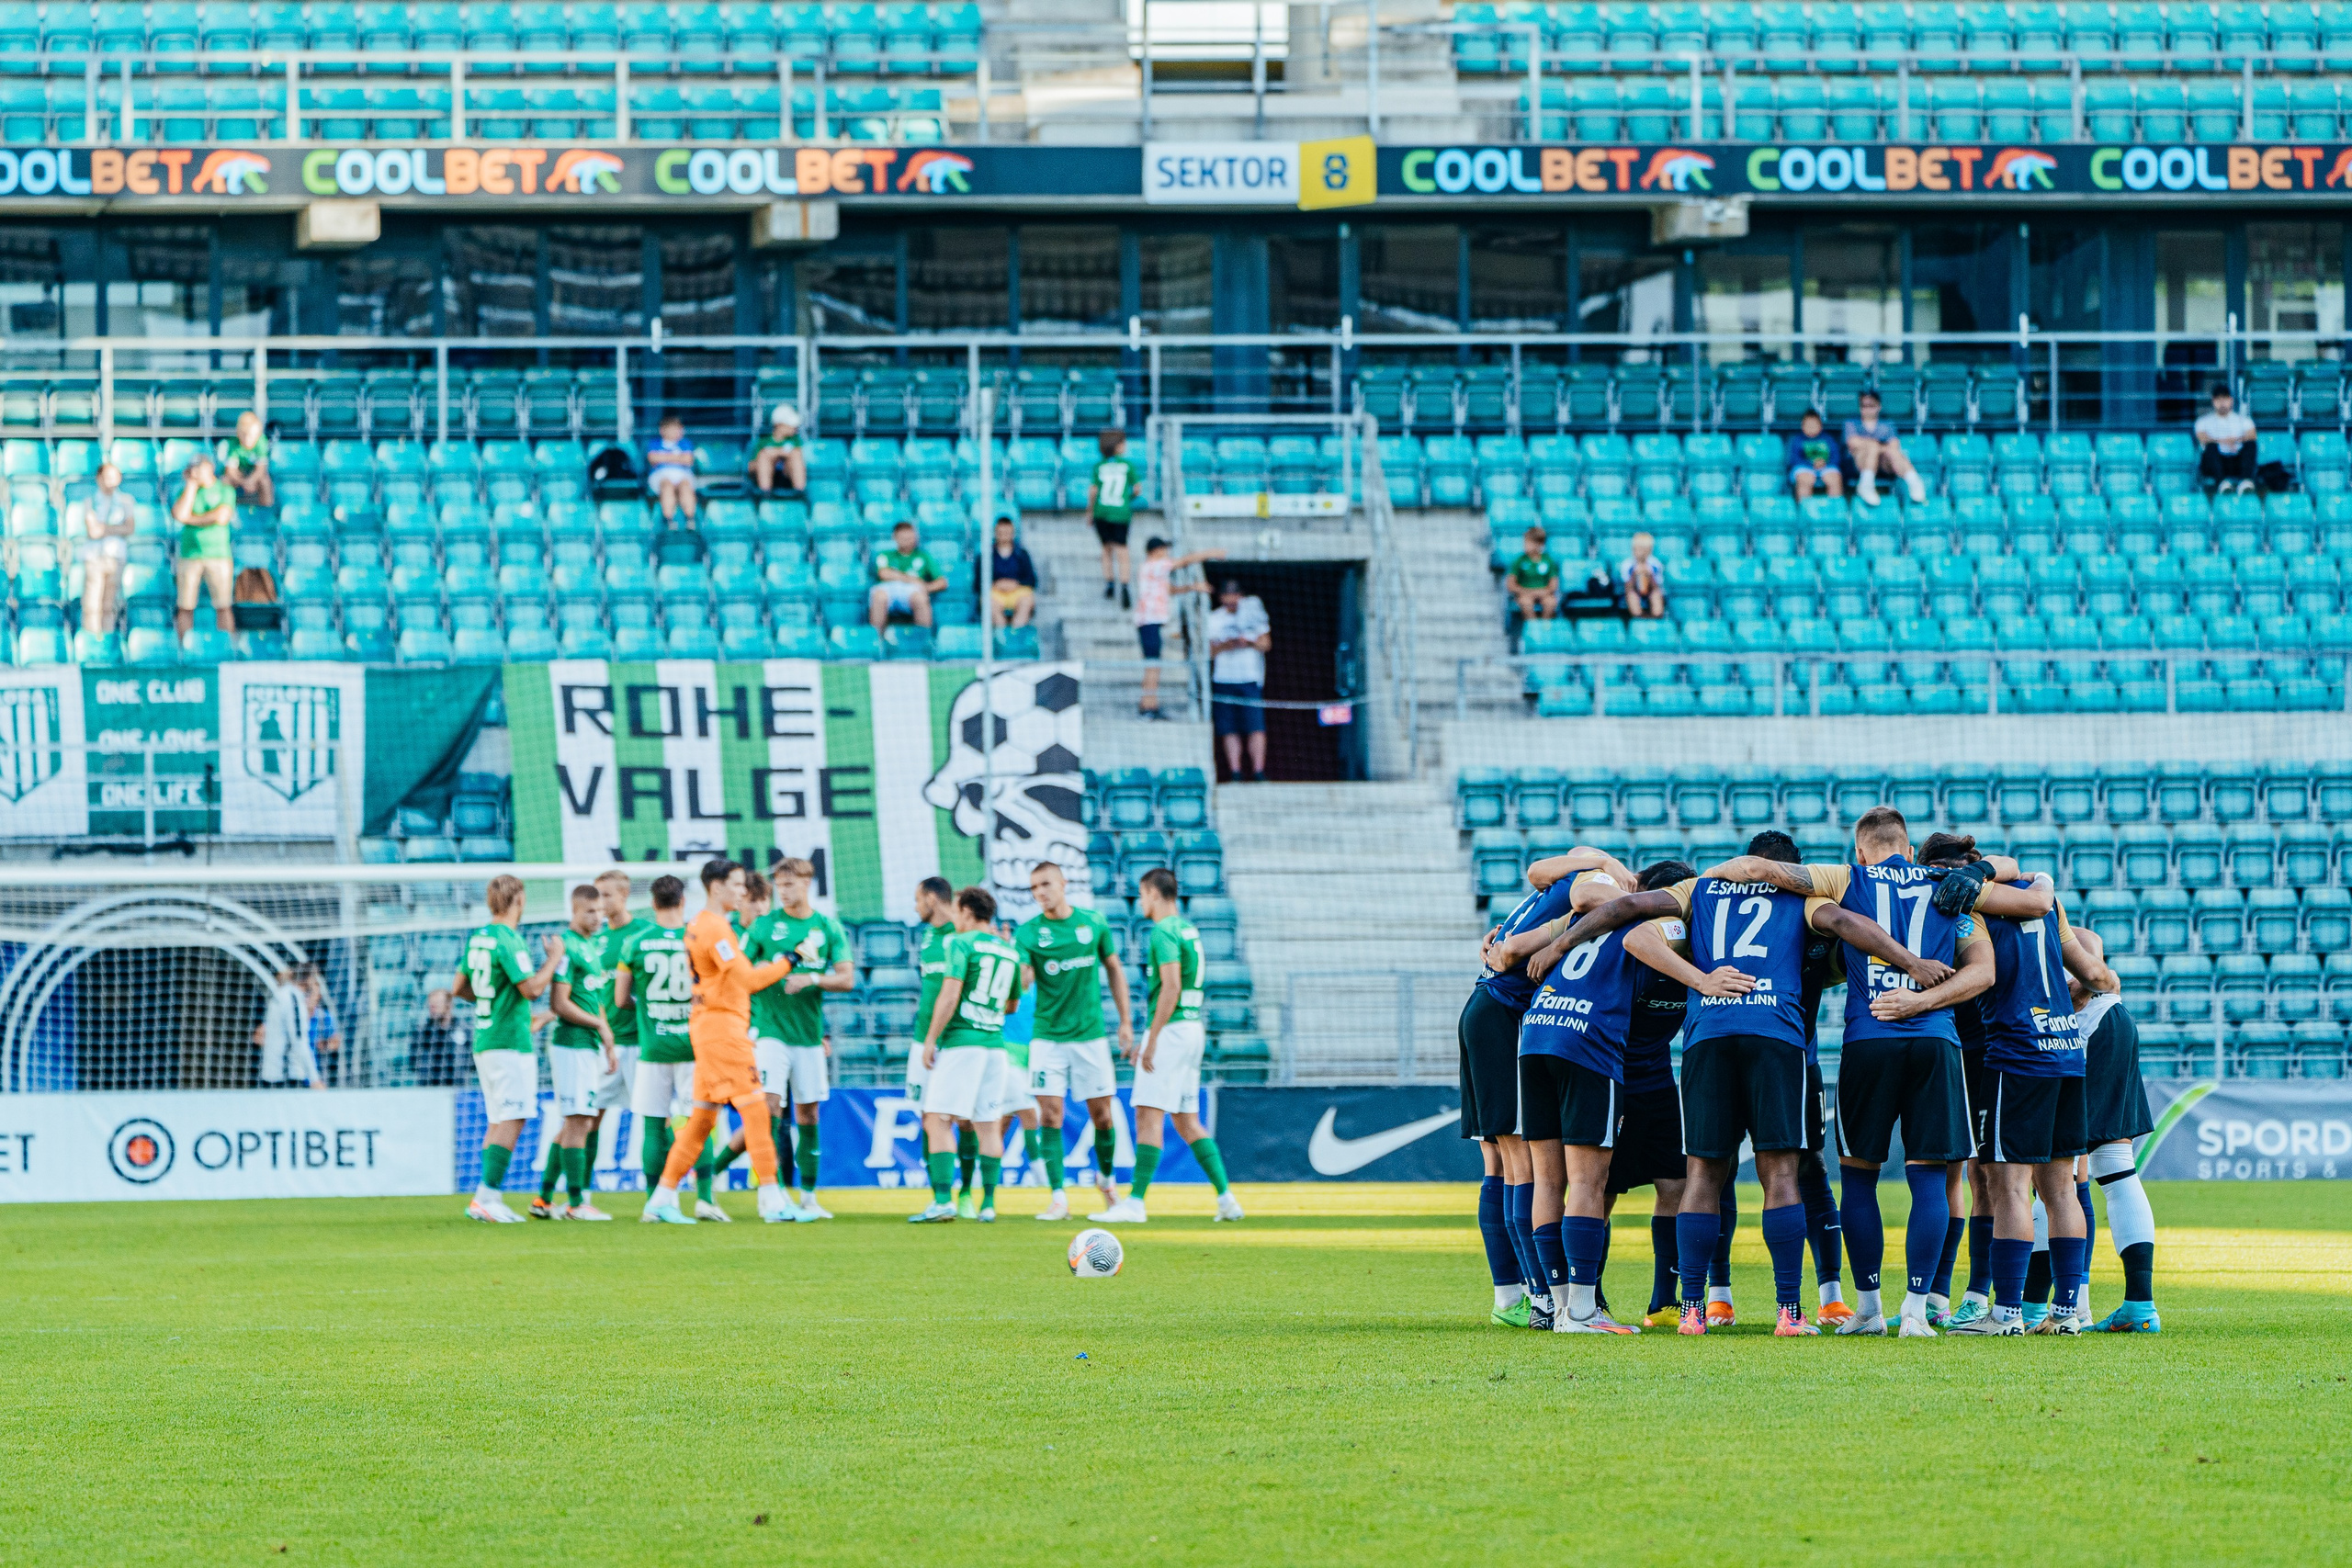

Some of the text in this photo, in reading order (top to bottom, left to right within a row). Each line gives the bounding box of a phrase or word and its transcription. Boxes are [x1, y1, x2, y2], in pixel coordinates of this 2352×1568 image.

[302, 149, 548, 195] COOLBET
[654, 148, 899, 195] COOLBET
[1156, 152, 1351, 190] SEKTOR 8
[1401, 148, 1640, 193] COOLBET
[1747, 147, 1983, 191] COOLBET
[2089, 146, 2324, 191] COOLBET
[96, 678, 206, 705] ONE CLUB
[560, 684, 855, 738] ROHE-
[555, 763, 873, 820] VALGE
[1713, 896, 1773, 961] 12
[1875, 881, 1933, 959] 17
[643, 950, 692, 1002] 28
[1561, 930, 1614, 981] 8
[2019, 918, 2052, 998] 7
[967, 954, 1016, 1010] 14
[1701, 993, 1778, 1008] NARVA LINN
[1523, 1013, 1589, 1034] NARVA LINN
[1532, 991, 1594, 1016] Fama
[2032, 1013, 2079, 1033] Fama
[1978, 1109, 1988, 1142] 7
[194, 1129, 381, 1171] OPTIBET
[2197, 1159, 2338, 1180] SPORTS &
[1551, 1269, 1559, 1279] 8
[1570, 1266, 1577, 1277] 8
[1868, 1272, 1879, 1284] 17
[1911, 1276, 1922, 1287] 17
[2067, 1290, 2075, 1300] 7
